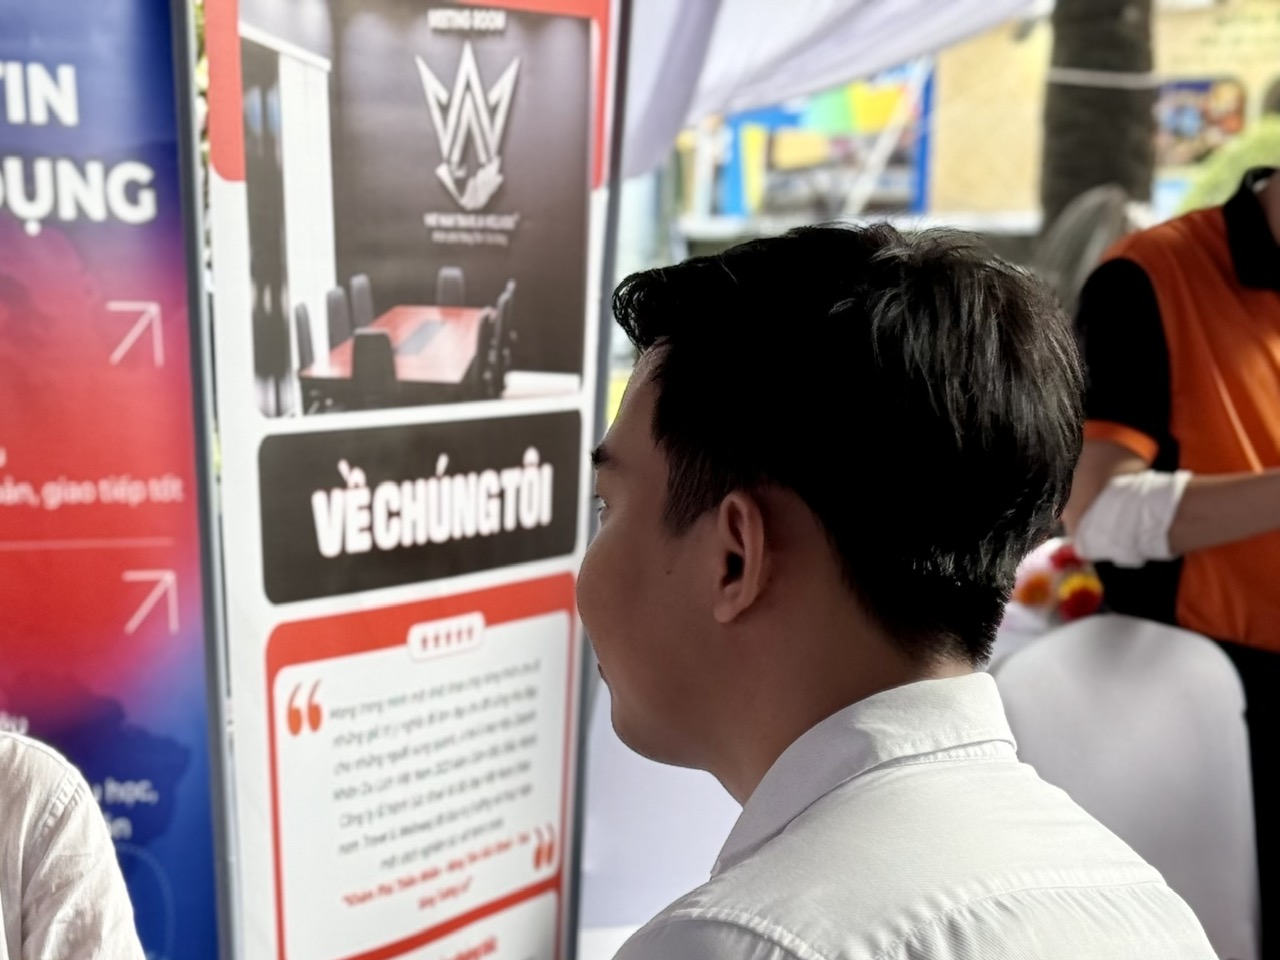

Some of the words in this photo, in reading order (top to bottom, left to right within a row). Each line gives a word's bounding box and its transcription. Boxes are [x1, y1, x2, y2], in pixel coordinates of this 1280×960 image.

[311, 458, 372, 558] VỀ
[372, 453, 502, 551] CHÚNG
[500, 446, 554, 532] TÔI
